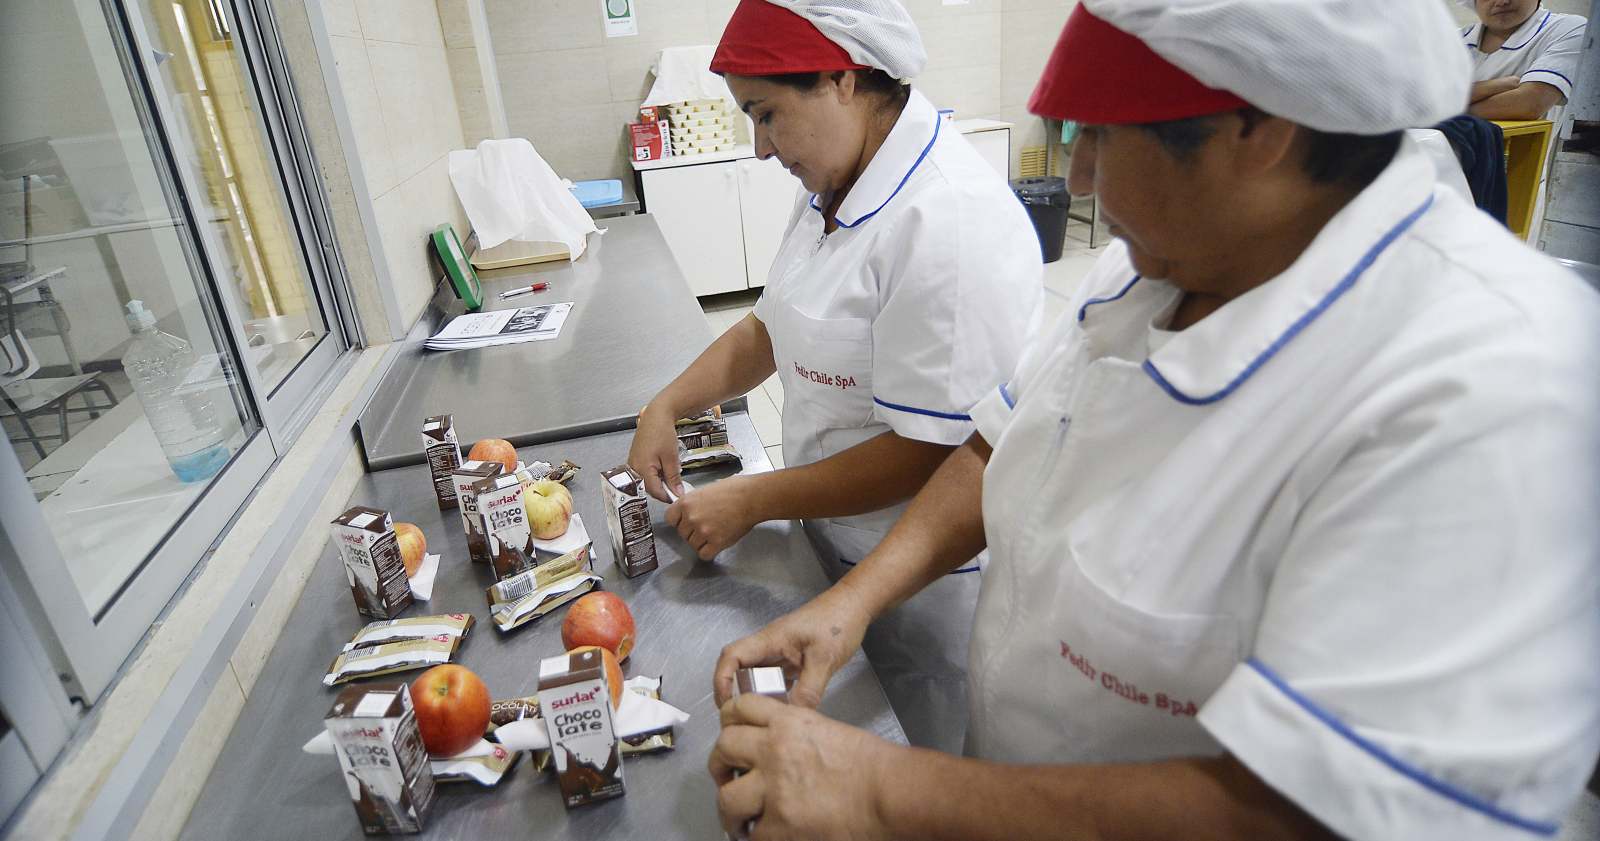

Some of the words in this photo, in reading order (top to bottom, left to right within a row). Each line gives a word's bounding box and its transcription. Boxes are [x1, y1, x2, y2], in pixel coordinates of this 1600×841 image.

[810, 370, 833, 386] Chile
[835, 375, 856, 389] SpA
[464, 503, 476, 511] la
[488, 494, 517, 508] surlat
[490, 508, 522, 521] Choco
[492, 516, 523, 531] late
[1060, 640, 1097, 681] Fedir
[1101, 671, 1149, 705] Chile
[1155, 693, 1198, 716] SpA
[552, 692, 595, 709] surlat
[554, 708, 601, 728] Choco
[558, 721, 603, 738] late
